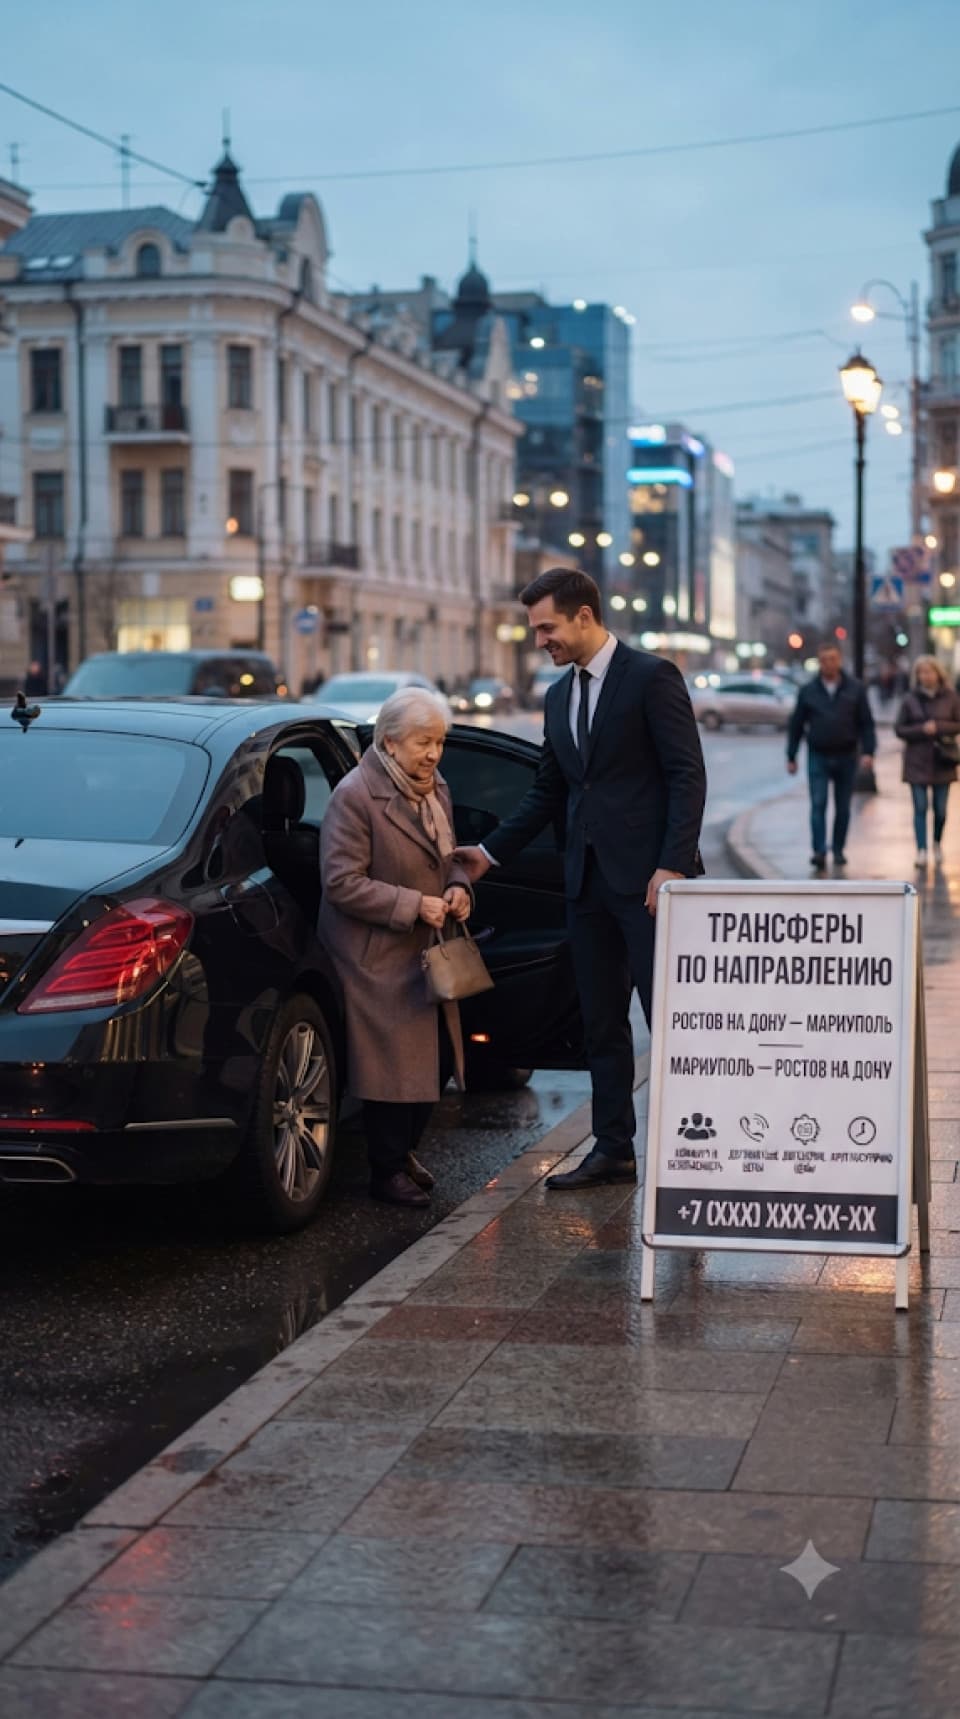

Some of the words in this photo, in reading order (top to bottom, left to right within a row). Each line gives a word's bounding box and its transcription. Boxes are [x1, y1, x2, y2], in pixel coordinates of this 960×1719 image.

[708, 912, 864, 944] ТРАНСФЕРЫ
[676, 954, 706, 983] ПО
[714, 955, 893, 986] НАПРАВЛЕНИЮ
[672, 1011, 723, 1031] РОСТОВ
[727, 1013, 745, 1031] НА
[748, 1013, 786, 1034] ДОНУ
[806, 1015, 893, 1034] МАРИУПОЛЬ
[670, 1056, 754, 1077] МАРИУПОЛЬ
[775, 1058, 827, 1079] РОСТОВ
[831, 1060, 850, 1079] НА
[853, 1060, 892, 1081] ДОНУ
[677, 1200, 702, 1225] +7
